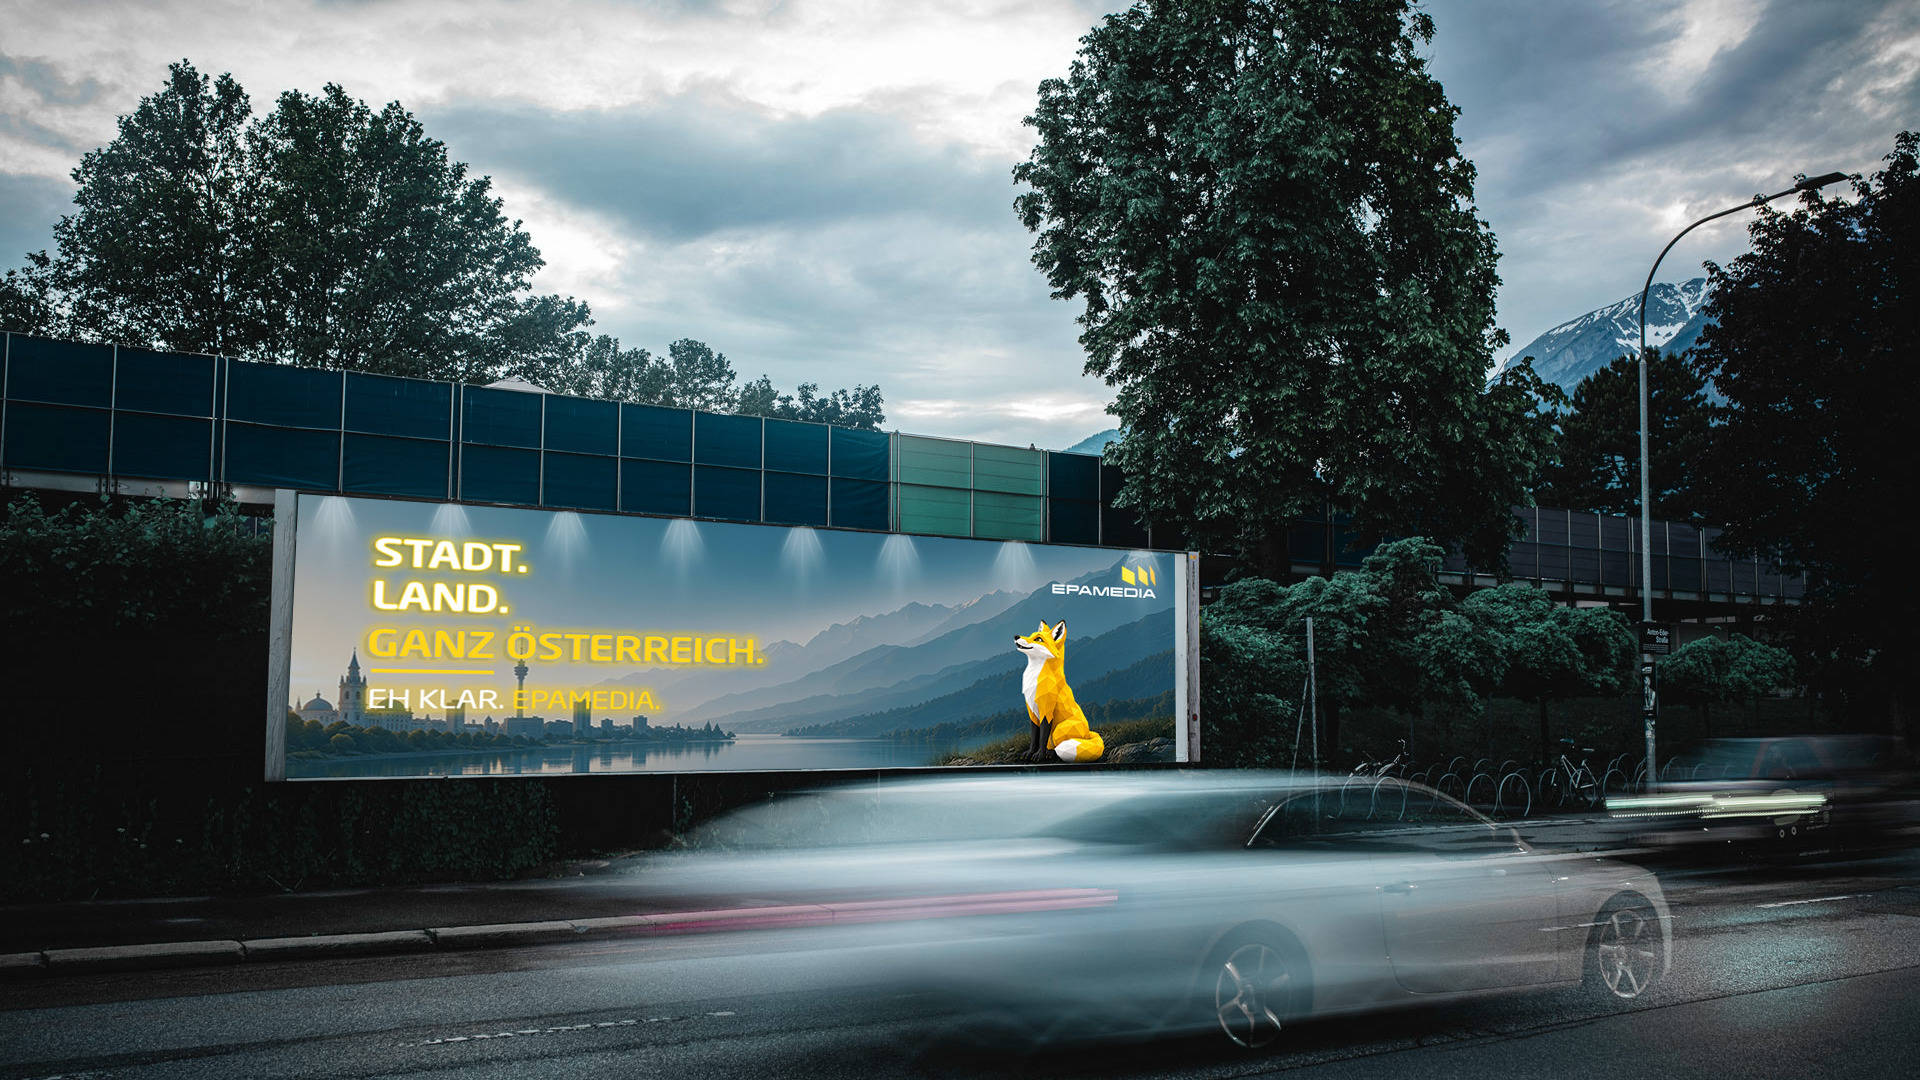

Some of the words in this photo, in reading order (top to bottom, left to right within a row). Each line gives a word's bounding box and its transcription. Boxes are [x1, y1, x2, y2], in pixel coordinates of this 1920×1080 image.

[375, 537, 528, 573] STADT.
[373, 580, 509, 614] LAND.
[1051, 583, 1156, 599] EPAMEDIA
[368, 628, 495, 659] GANZ
[507, 625, 764, 664] ÖSTERREICH.
[368, 688, 409, 709] EH
[419, 689, 504, 710] KLAR.
[513, 689, 660, 710] EPAMEDIA.
